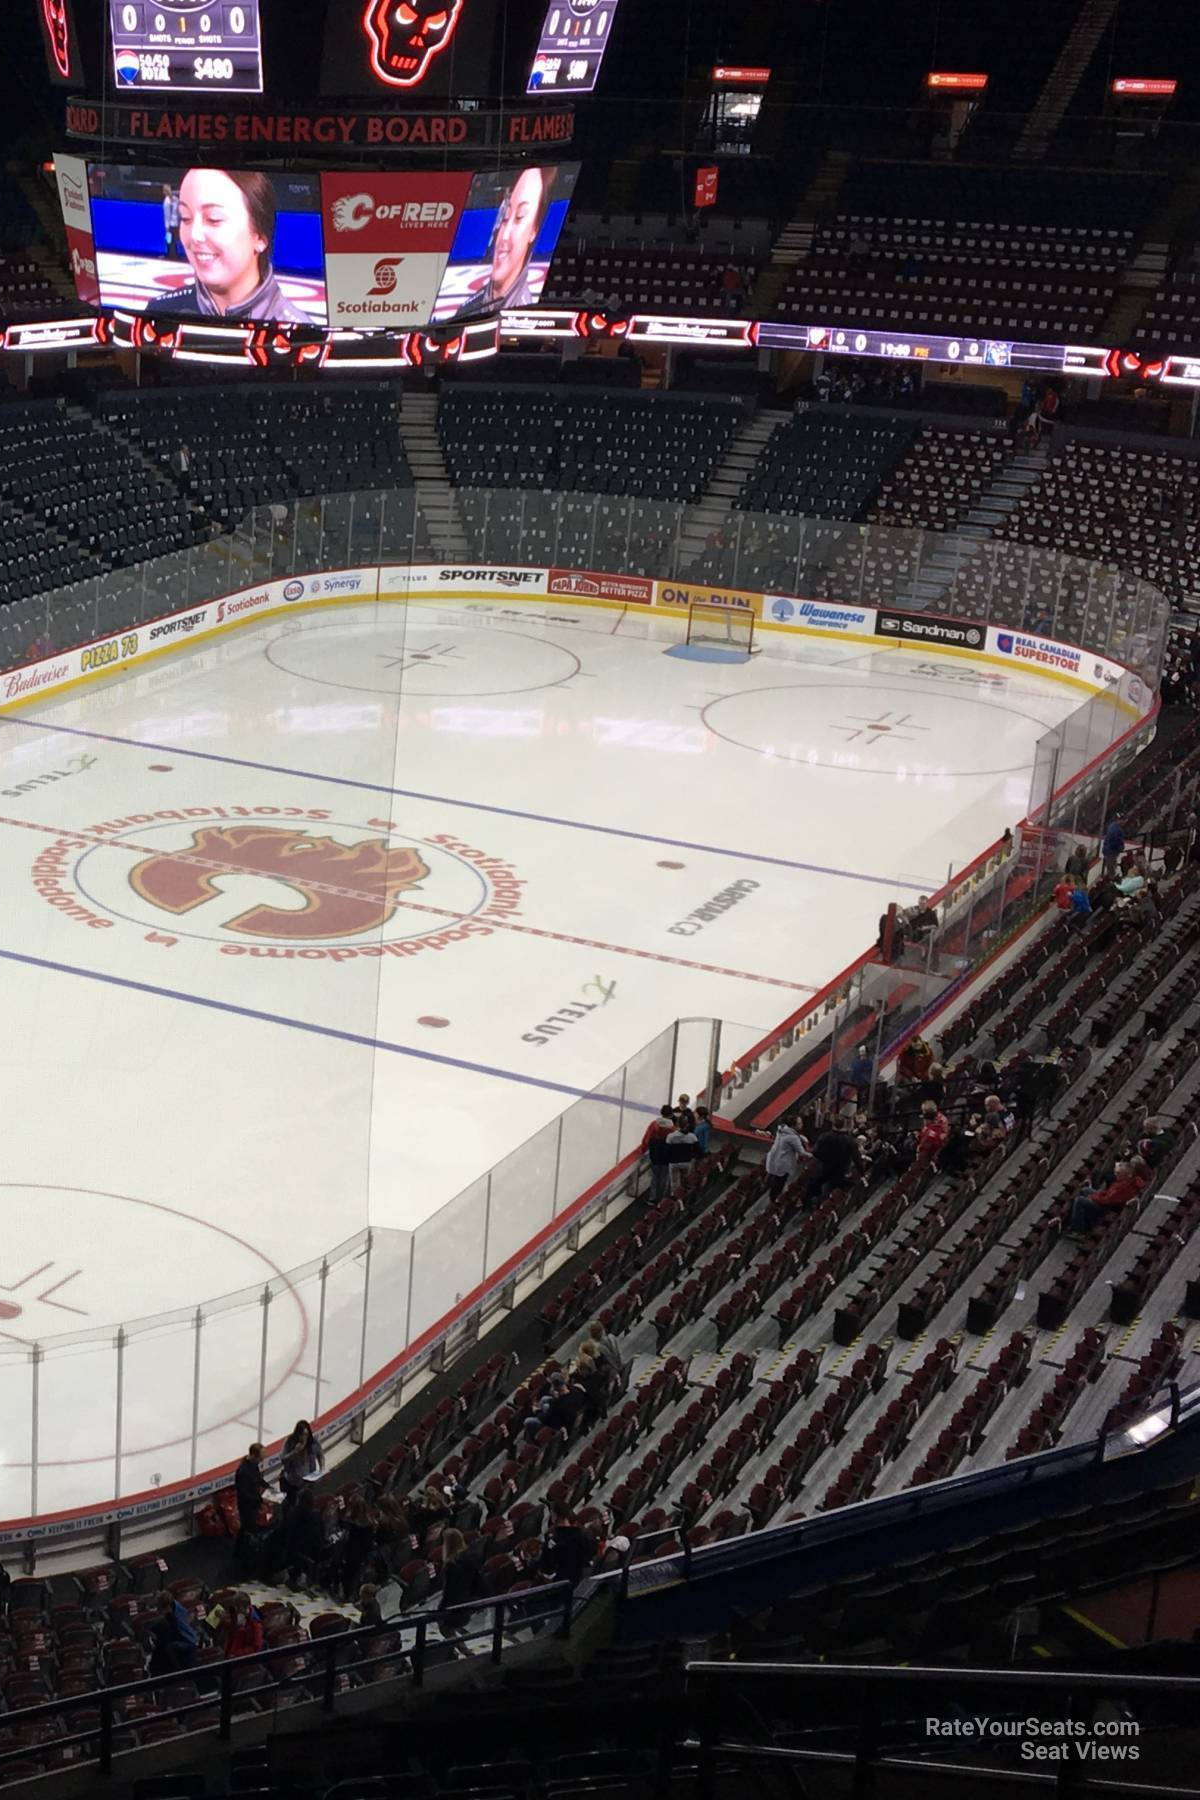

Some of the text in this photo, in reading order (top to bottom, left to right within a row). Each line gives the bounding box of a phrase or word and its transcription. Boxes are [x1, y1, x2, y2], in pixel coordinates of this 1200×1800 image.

[122, 4, 138, 32] 0
[154, 13, 166, 32] 0
[200, 13, 211, 33] 0
[229, 6, 245, 34] 0
[193, 56, 234, 80] $480
[129, 112, 468, 143] FLAMES ENERGY BOARD
[375, 204, 402, 219] OF
[401, 202, 455, 221] RED
[336, 300, 420, 314] Scotiabank
[855, 334, 867, 351] 0
[948, 341, 960, 359] 0
[323, 576, 362, 592] Synergy
[438, 569, 545, 584] SPORTSNET
[226, 591, 271, 616] Scotiabank
[601, 587, 626, 596] BETTER
[661, 588, 689, 605] ON
[149, 610, 207, 640] SPORTSNET
[799, 602, 866, 624] Wawanesa
[806, 617, 849, 630] Insurance
[902, 620, 965, 641] Sandman
[80, 633, 139, 672] PIZZA 73
[1013, 645, 1080, 673] SUPERSTORE
[1015, 636, 1081, 662] REAL CANADIAN
[3, 662, 70, 698] Budweiser
[0, 770, 73, 799] TELUS
[93, 803, 334, 836] Scotiabank
[29, 838, 115, 931] Saddledome
[423, 832, 529, 920] Scotiabank
[666, 877, 760, 937] CARSTAR.ca
[219, 921, 496, 963] Saddledome
[520, 1000, 598, 1047] TELUS
[136, 1501, 161, 1516] KEEPING
[168, 1493, 187, 1505] FRESH
[48, 1521, 75, 1535] KEEPING
[84, 1516, 104, 1528] FRESH
